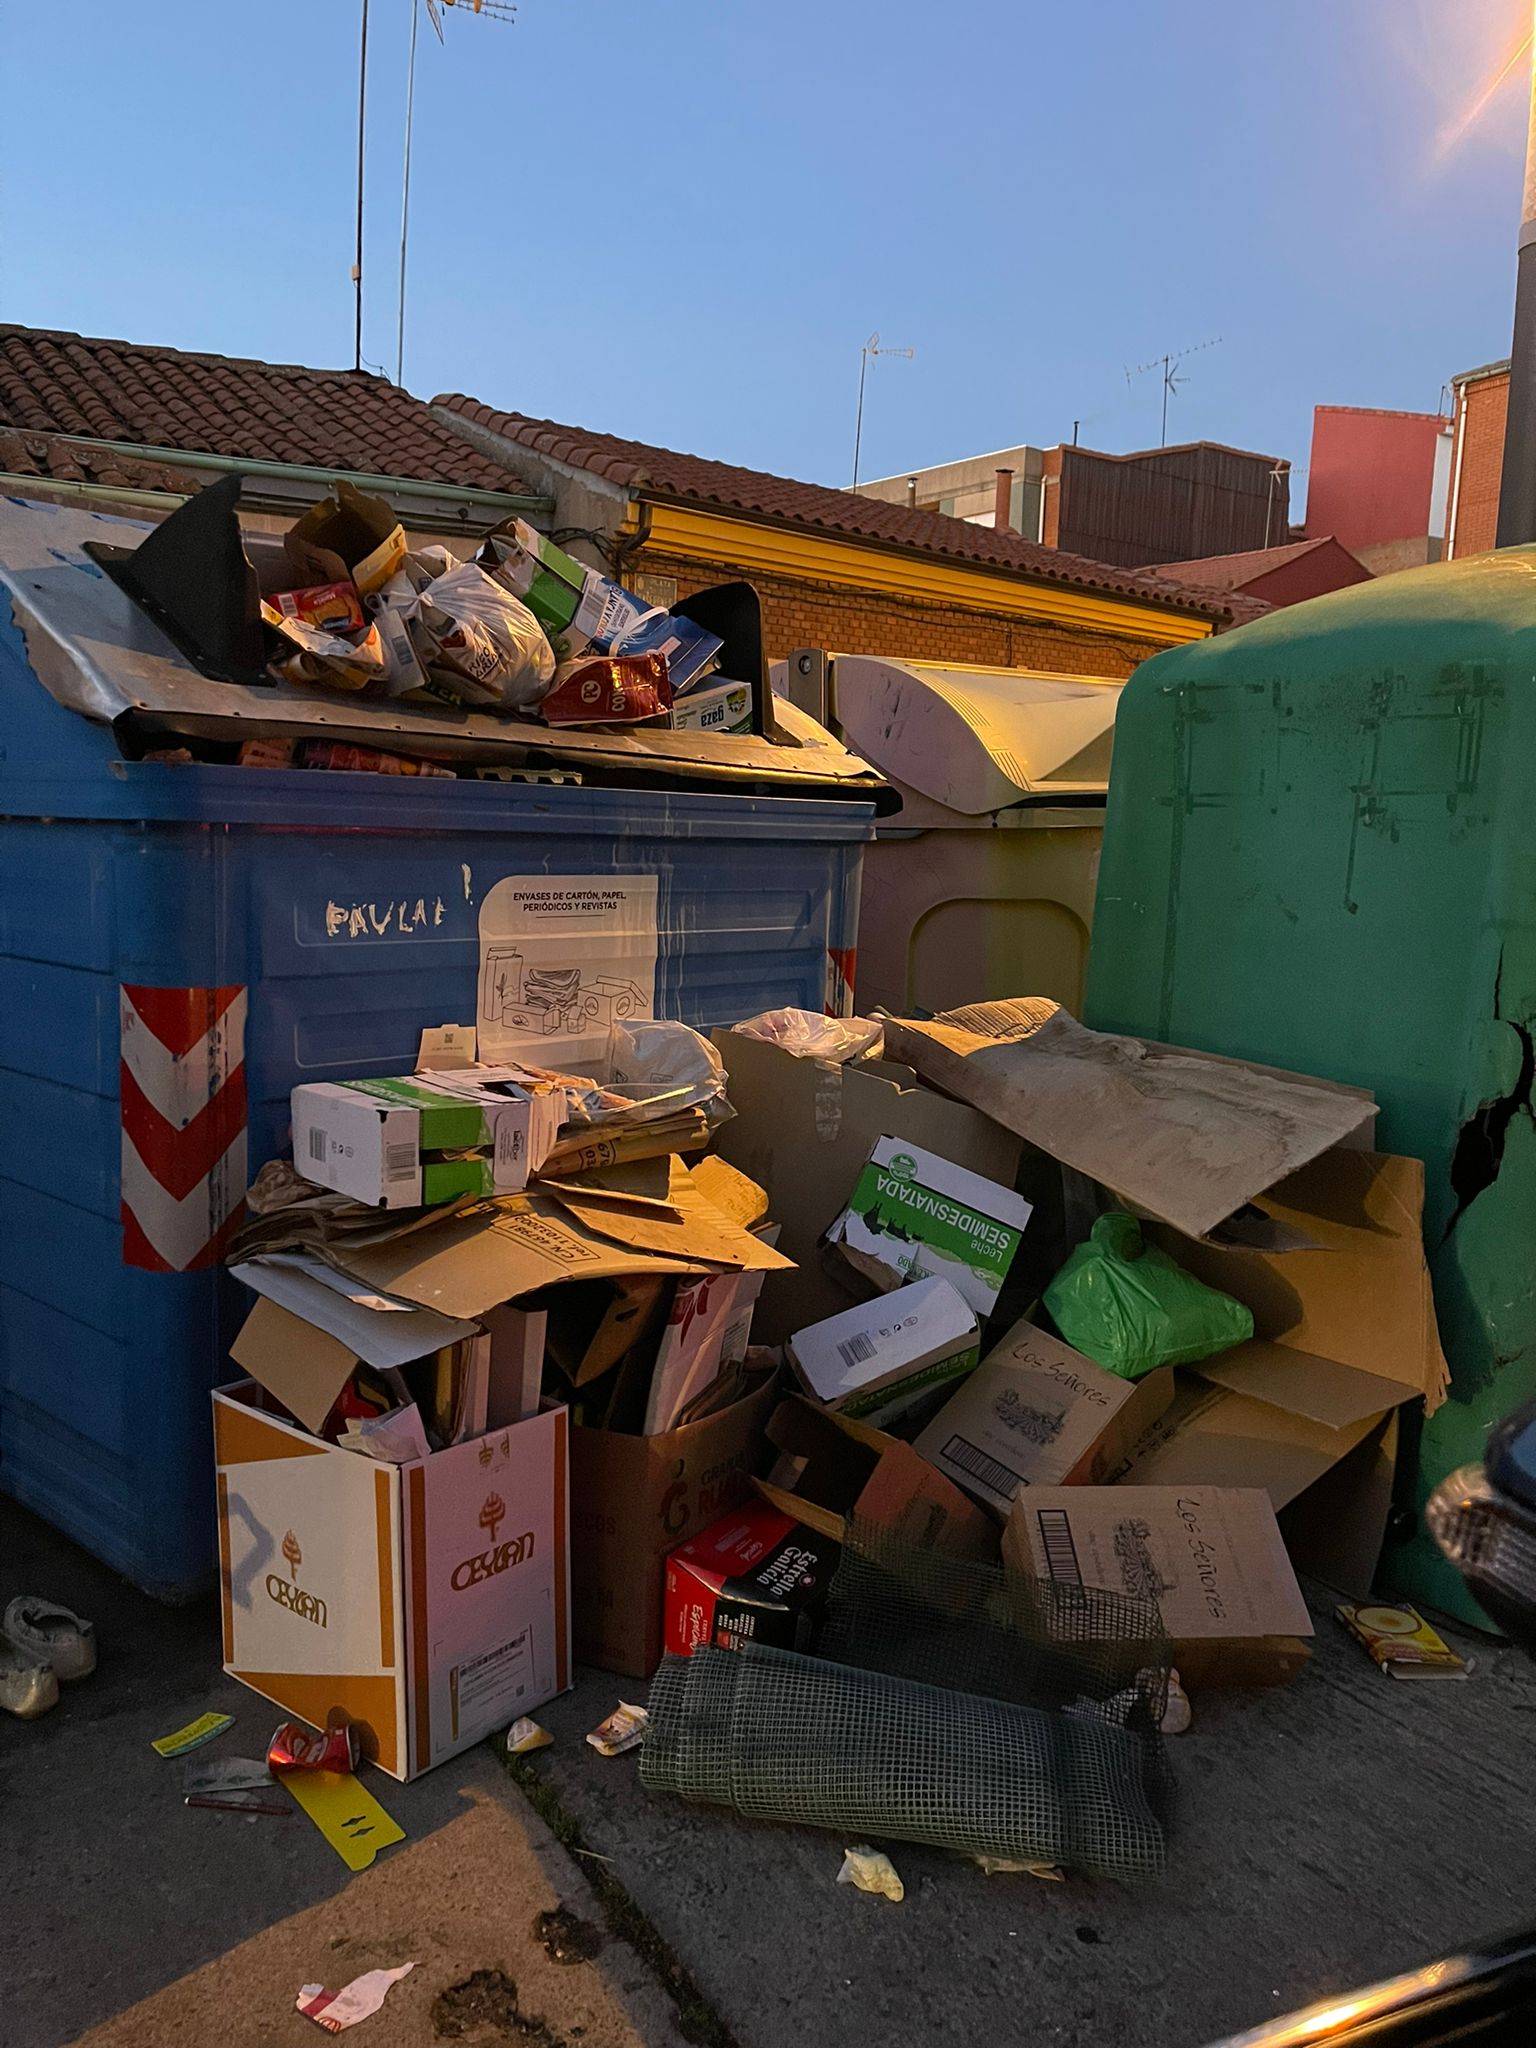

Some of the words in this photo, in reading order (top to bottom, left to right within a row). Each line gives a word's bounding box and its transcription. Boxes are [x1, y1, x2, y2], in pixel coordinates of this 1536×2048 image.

[701, 704, 724, 727] gaza
[513, 891, 551, 901] ENVASES
[552, 891, 564, 901] DE
[566, 889, 600, 901] CARTÓN,
[601, 891, 627, 900] PAPEL,
[523, 901, 572, 912] PERIÓDICOS
[574, 902, 580, 910] Y
[582, 901, 617, 911] REVISTAS
[876, 1173, 1013, 1252] SEMIDESNATADA
[970, 1236, 1005, 1264] Leche
[1011, 1340, 1041, 1371] Los
[1043, 1361, 1114, 1409] Señores
[757, 1546, 802, 1586] Galicia
[770, 1551, 818, 1600] Estrella
[1175, 1496, 1202, 1536] Los
[1189, 1535, 1230, 1619] Señores
